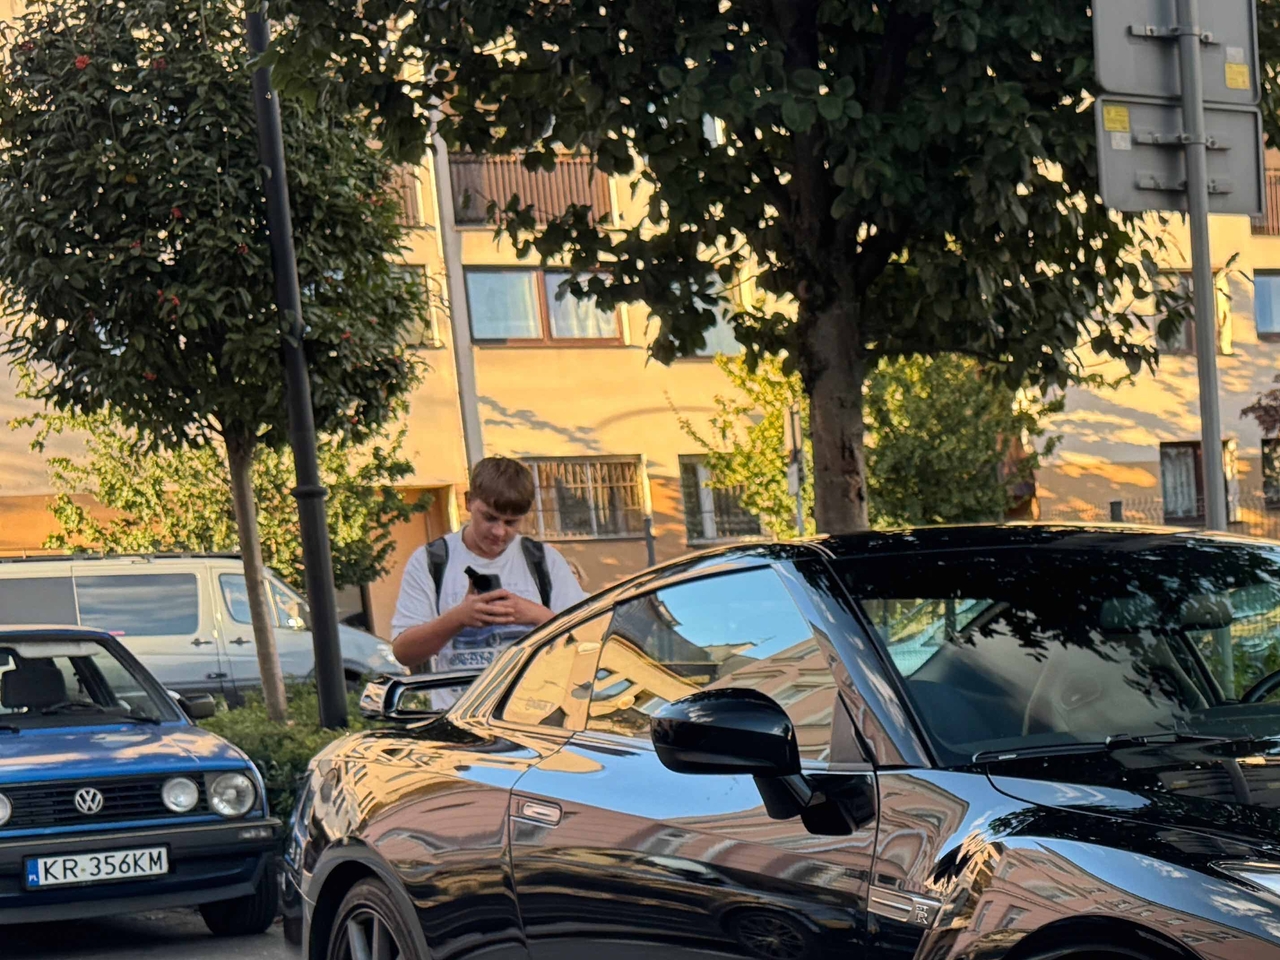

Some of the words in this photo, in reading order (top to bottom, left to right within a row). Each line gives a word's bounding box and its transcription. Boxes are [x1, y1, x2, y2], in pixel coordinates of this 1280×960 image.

[75, 787, 103, 814] VW
[43, 859, 79, 881] KR
[89, 850, 162, 877] 356KM
